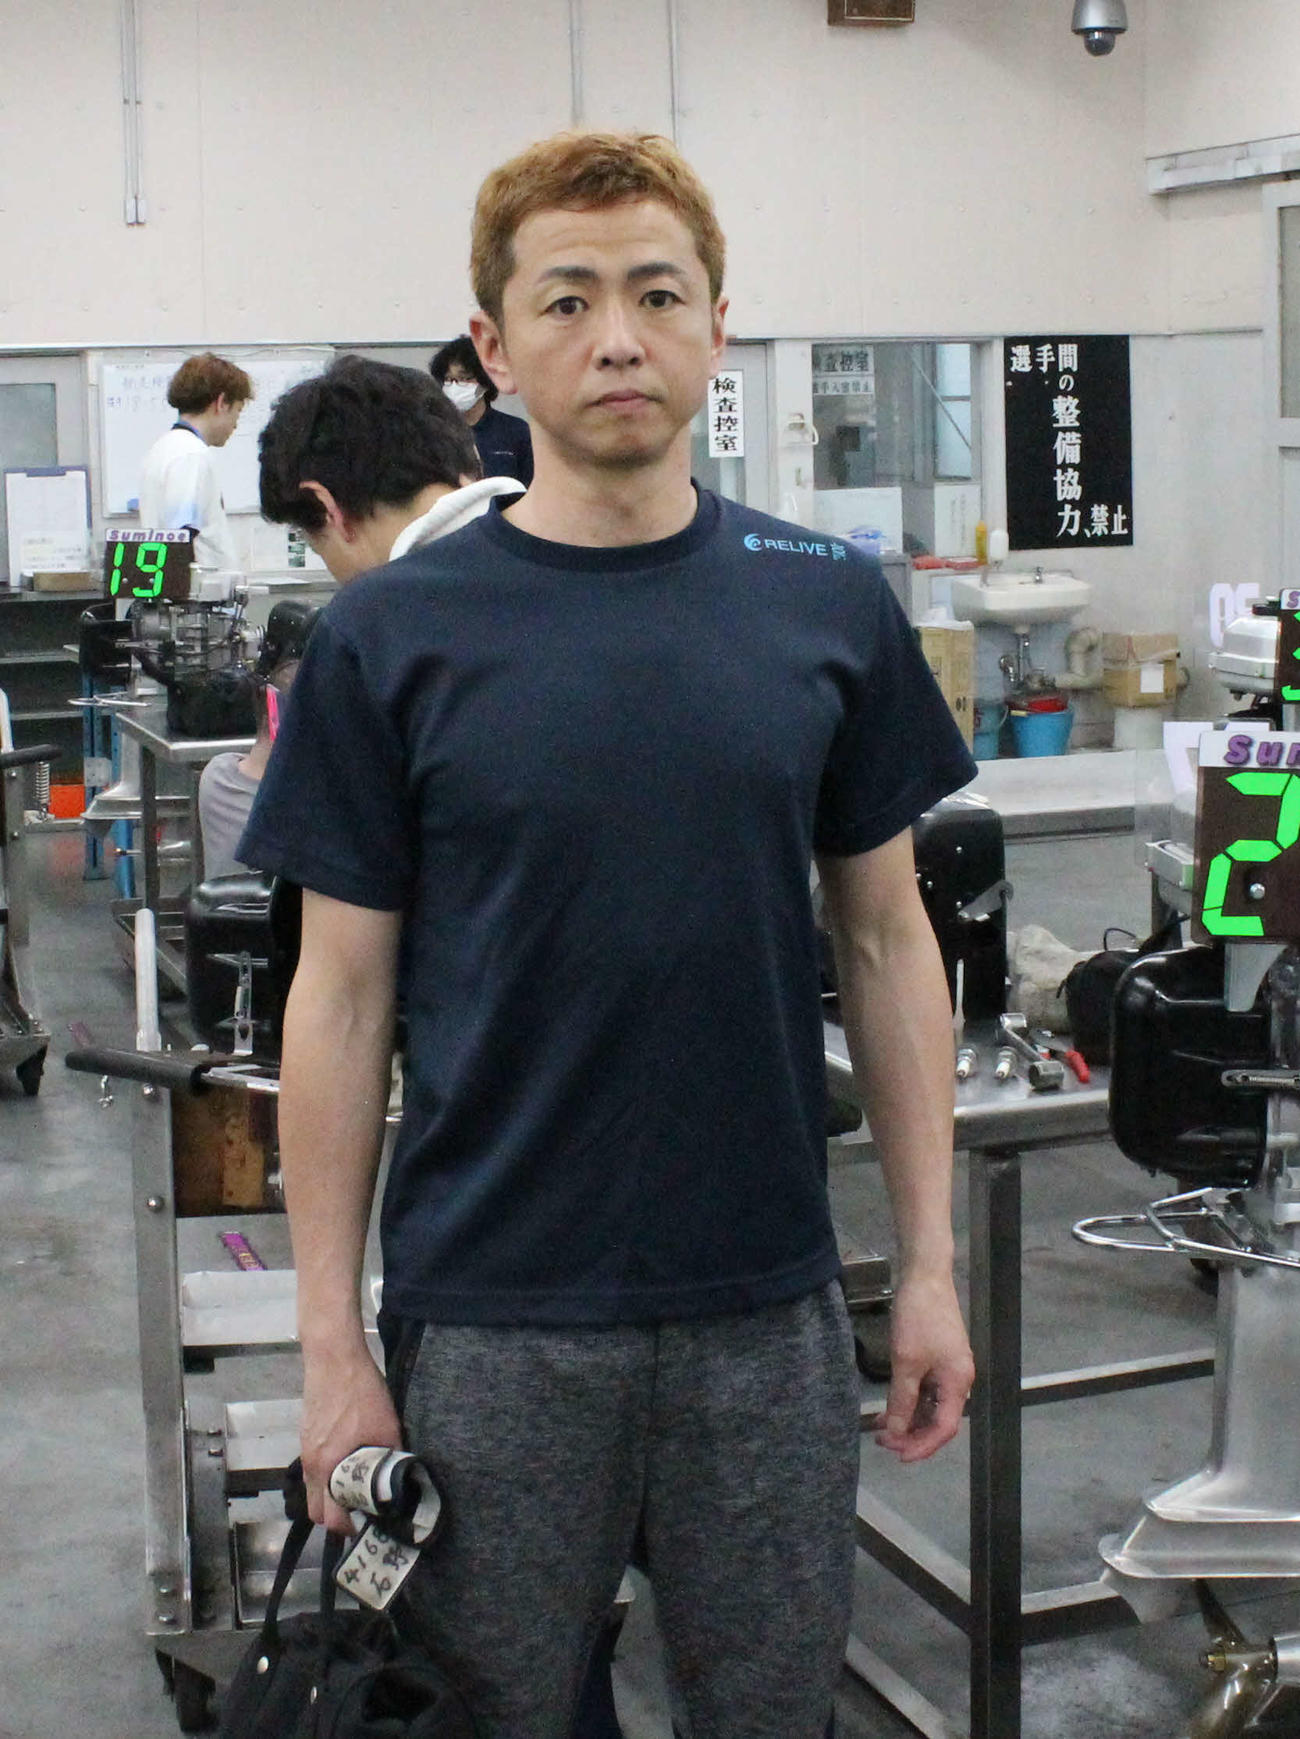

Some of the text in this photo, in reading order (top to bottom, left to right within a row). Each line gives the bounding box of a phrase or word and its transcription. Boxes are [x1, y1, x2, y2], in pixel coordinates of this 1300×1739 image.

[712, 377, 738, 452] 検査控室
[110, 529, 186, 541] Suminoe
[764, 539, 828, 556] RELIVE
[110, 542, 168, 598] 19
